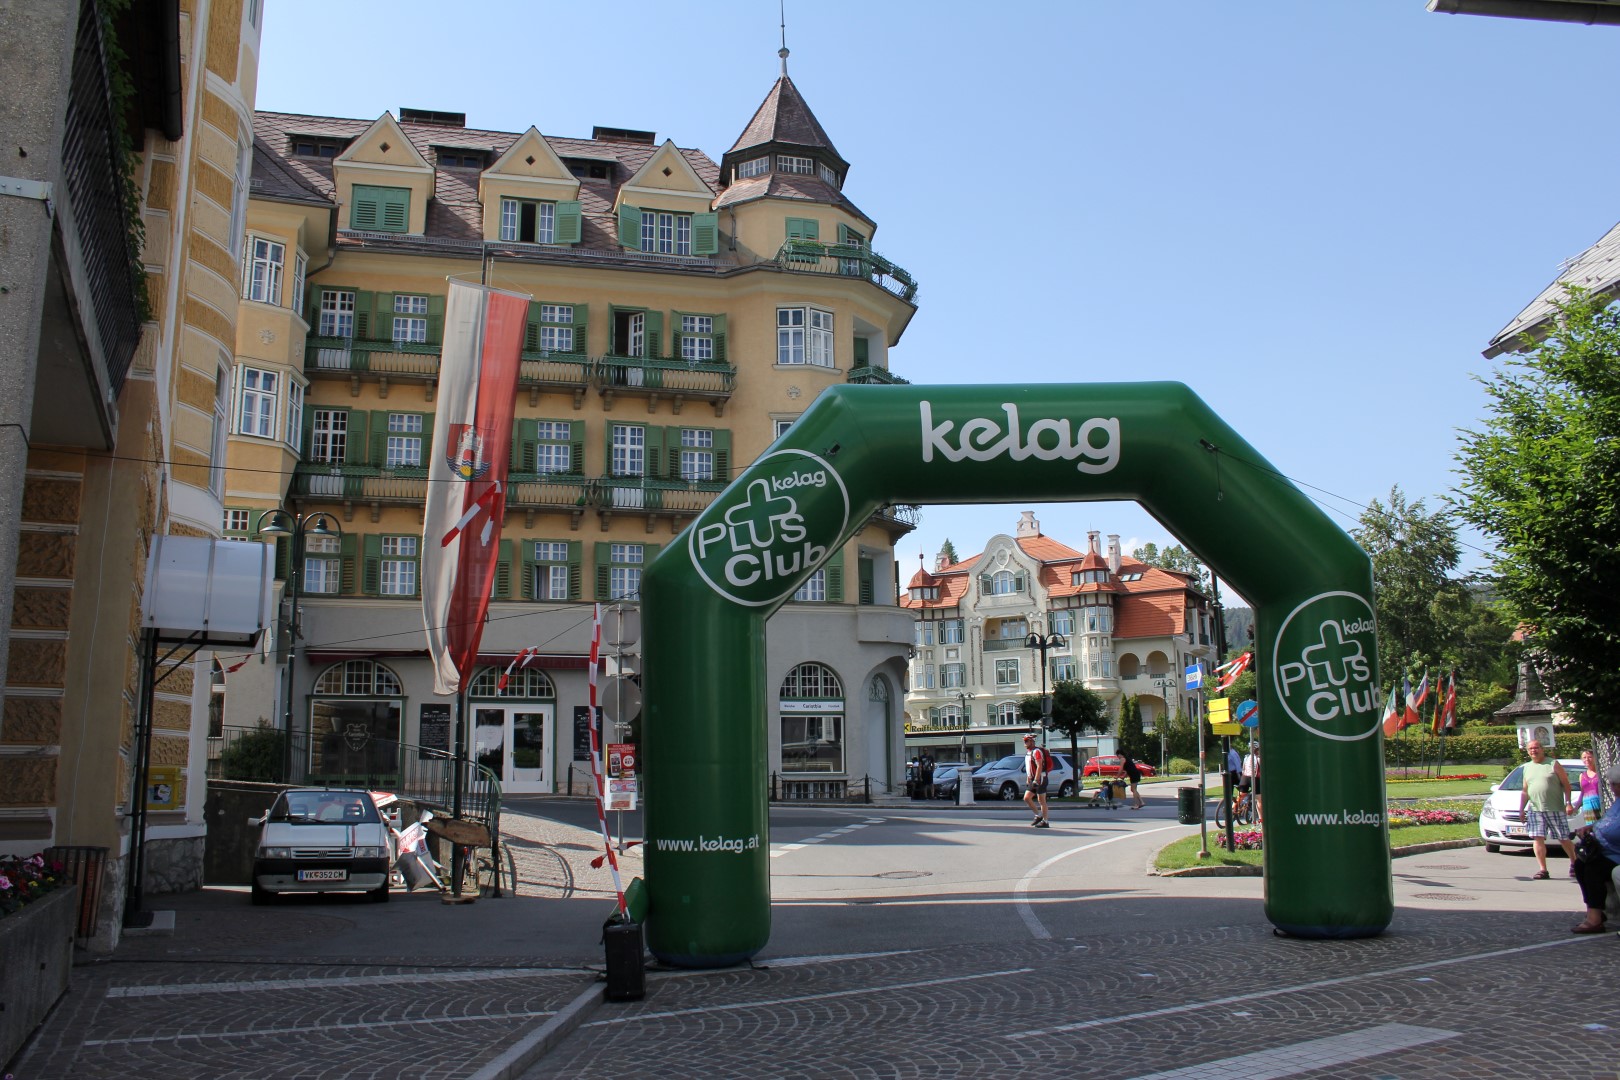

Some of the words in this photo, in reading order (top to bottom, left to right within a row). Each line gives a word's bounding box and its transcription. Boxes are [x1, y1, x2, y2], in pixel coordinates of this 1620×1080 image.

[918, 400, 1121, 475] kelag
[771, 470, 827, 492] kelag
[698, 513, 807, 560] PLUS
[724, 542, 826, 587] Club
[1342, 617, 1375, 635] kelag
[1279, 656, 1371, 697] PLUS
[1294, 808, 1386, 828] www.kelag.
[657, 834, 760, 854] www.kelag.at
